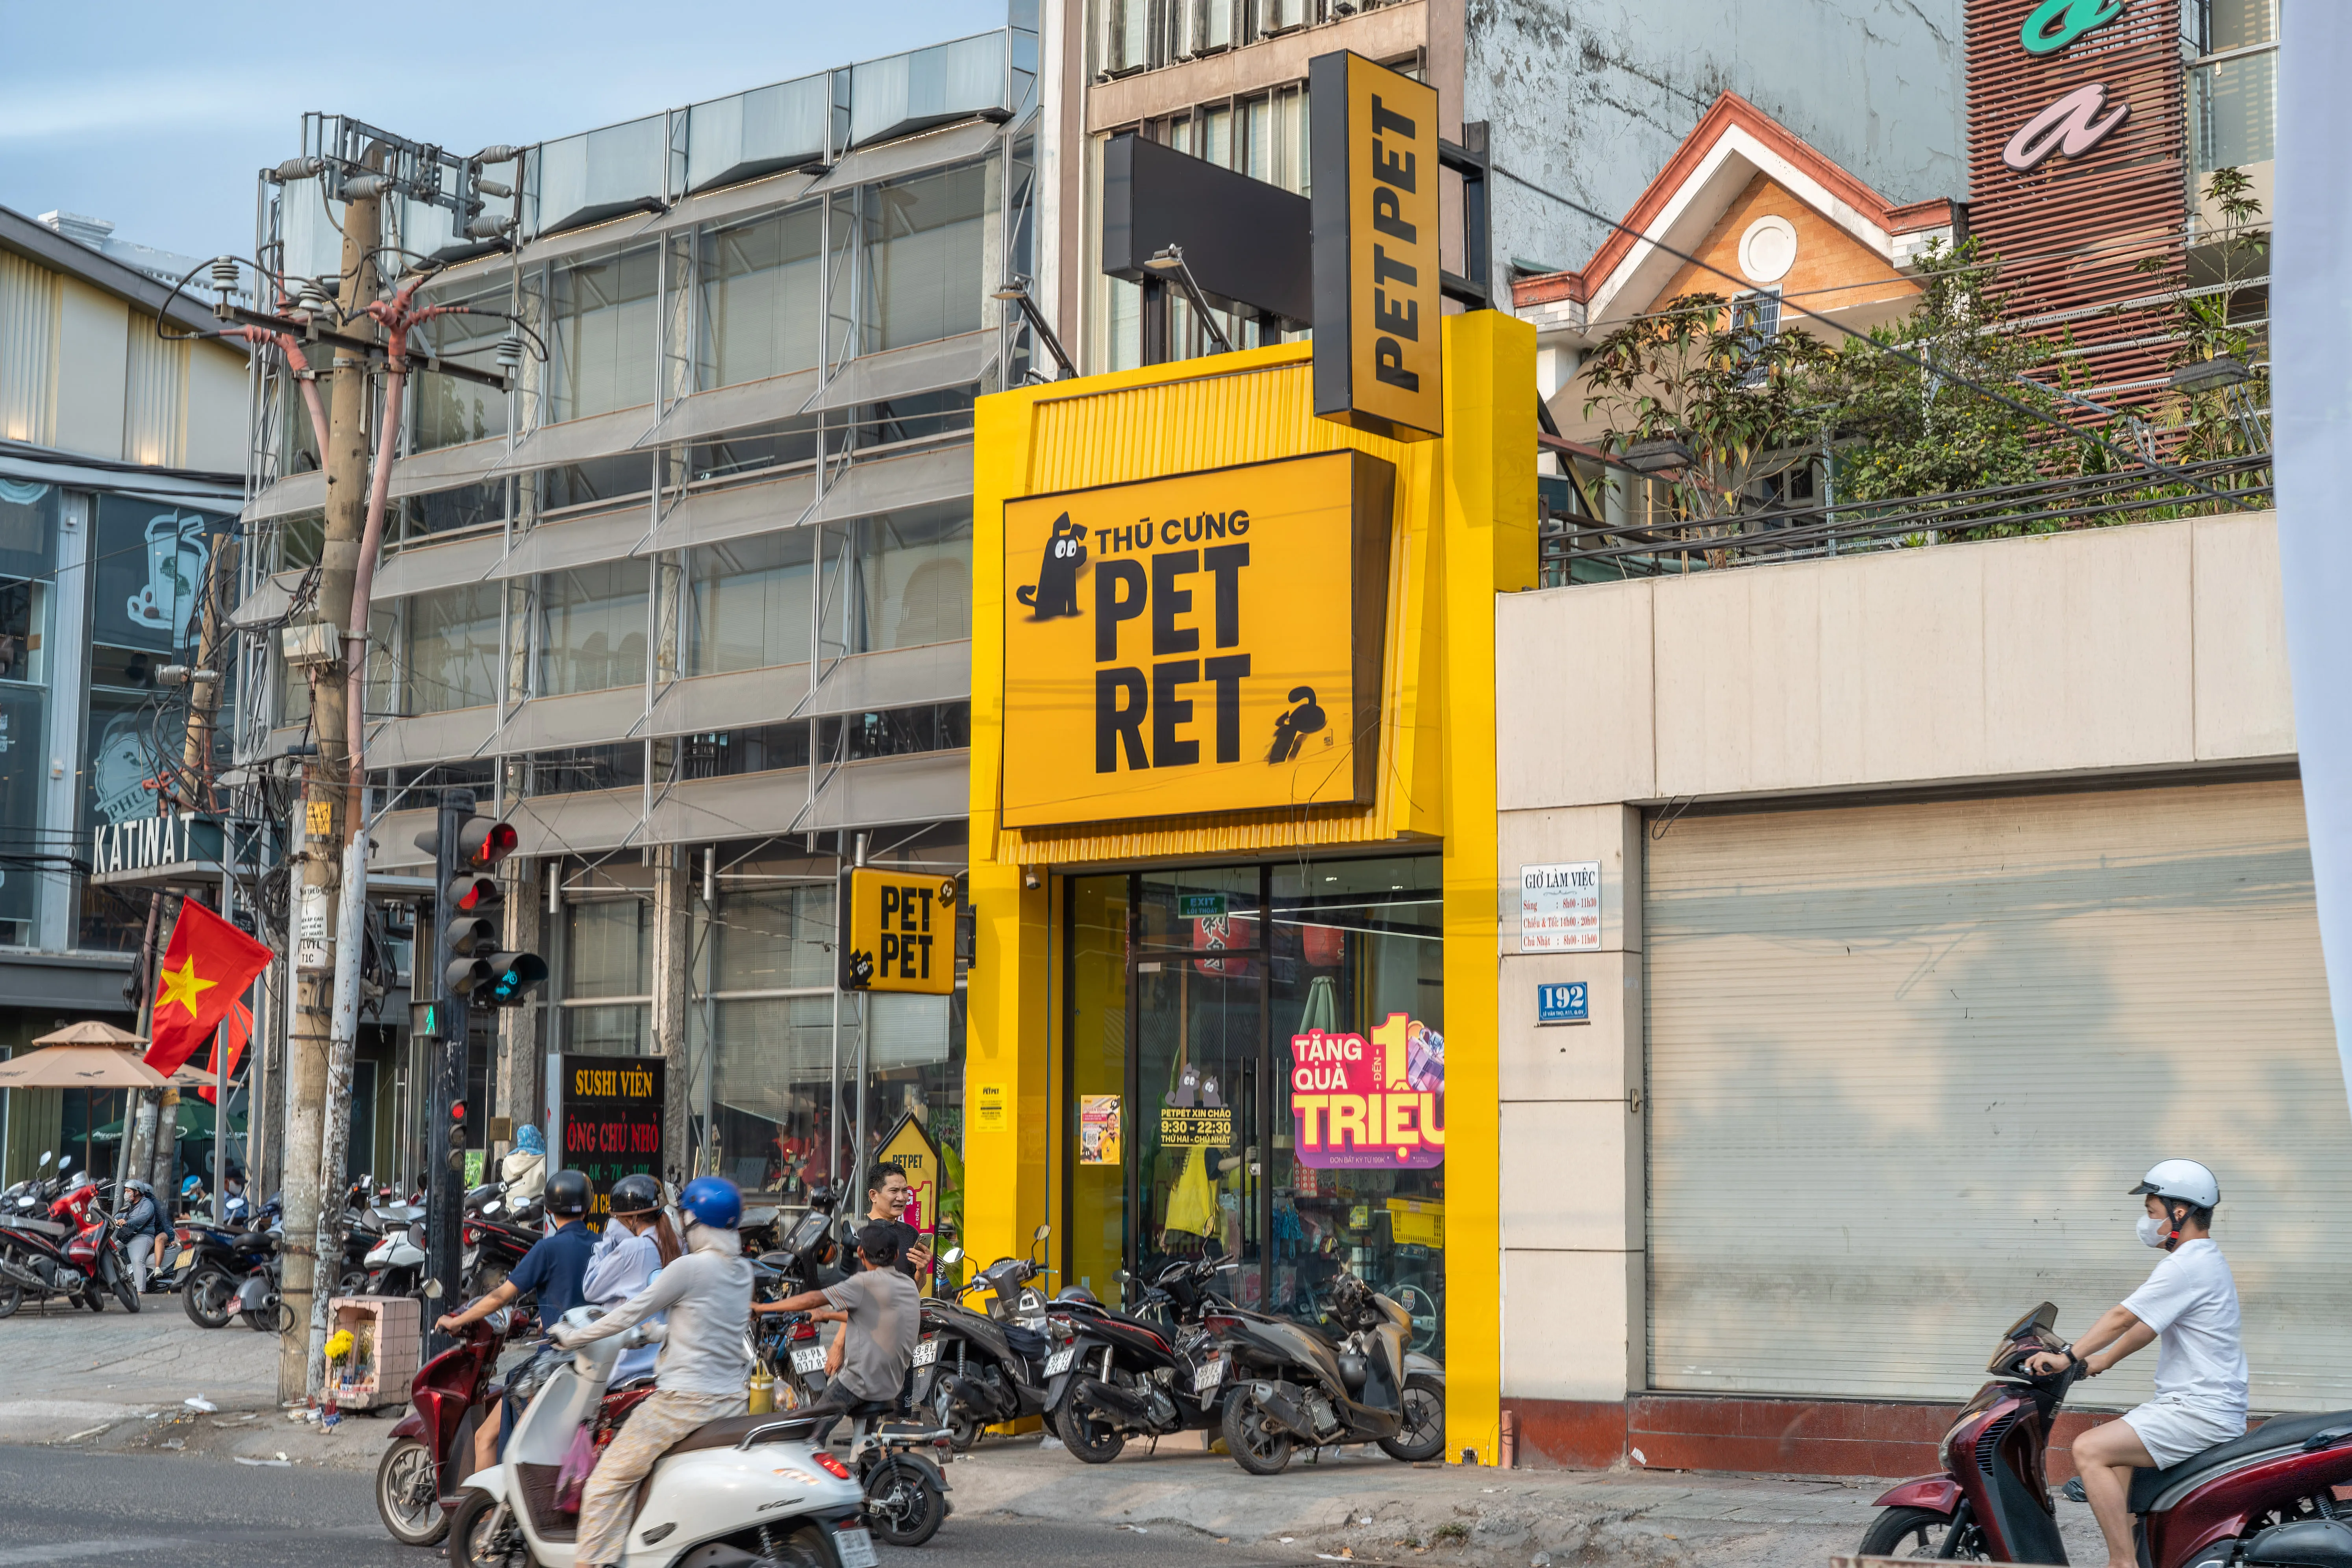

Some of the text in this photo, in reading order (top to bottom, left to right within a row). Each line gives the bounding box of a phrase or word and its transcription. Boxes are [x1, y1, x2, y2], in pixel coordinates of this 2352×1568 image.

[1095, 510, 1250, 554] THÚ CƯNG
[1095, 542, 1250, 663] PET
[1095, 653, 1251, 774] RET
[93, 812, 195, 874] KATINAT
[1526, 867, 1595, 890] GIỜ LÀM VIỆC
[881, 885, 933, 932] PET
[1190, 897, 1215, 907] EXIT
[1523, 900, 1537, 913] Sáng
[1563, 898, 1576, 909] 8h00
[1581, 897, 1596, 908] 11h30
[1542, 917, 1546, 928] &
[1560, 916, 1576, 927] 14h00
[1581, 915, 1597, 926] 20h00
[1524, 935, 1535, 947] Chủ
[1537, 935, 1550, 948] Nhật
[1563, 934, 1576, 945] 8h00
[1582, 933, 1597, 944] 11h00
[880, 933, 933, 979] PET
[1544, 986, 1584, 1010] 192
[1295, 1033, 1362, 1066] TẶNG
[1373, 1015, 1406, 1090] 1
[576, 1064, 653, 1098] SUSHI VIÊN
[1295, 1062, 1348, 1090] QUÀ
[1372, 1057, 1382, 1081] ĐẾN
[1192, 1109, 1206, 1118] XIN
[1207, 1107, 1231, 1118] CHÀO
[1294, 1081, 1445, 1157] TRIỆU
[567, 1111, 659, 1153] ÔNG CHỦ NHỎ
[1161, 1121, 1187, 1133] 9:30
[1197, 1121, 1231, 1134] 22:30
[1161, 1133, 1176, 1143] THỨ
[1177, 1135, 1189, 1143] HAI
[1194, 1133, 1210, 1144] CHỦ
[1211, 1134, 1231, 1145] NHẬT
[589, 1164, 601, 1181] 4K
[610, 1164, 622, 1181] 7K
[916, 1184, 931, 1229] 1
[913, 1352, 933, 1365] 05.21
